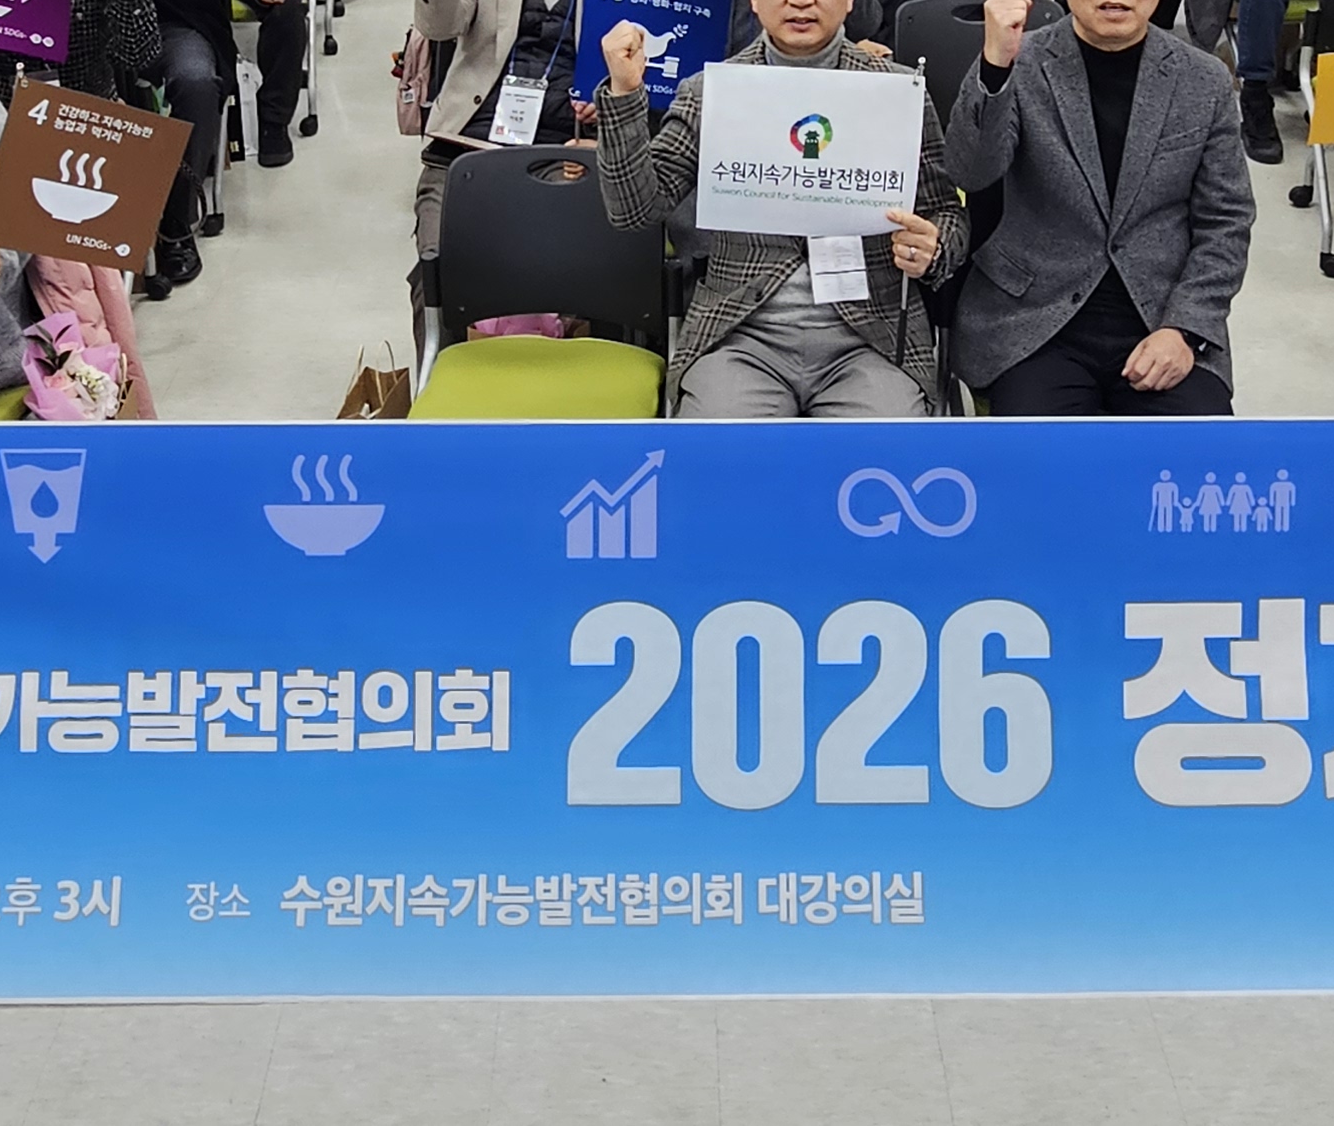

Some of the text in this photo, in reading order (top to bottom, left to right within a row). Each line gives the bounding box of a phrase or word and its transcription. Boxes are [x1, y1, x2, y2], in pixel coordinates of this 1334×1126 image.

[28, 99, 50, 125] 4
[58, 103, 154, 139] 건강하고 지속가능한
[54, 118, 123, 144] 농업과 먹거리
[711, 160, 906, 193] 수원지속가능발전협의회
[711, 185, 904, 209] Suwon Council for Sustainable Development
[66, 234, 82, 245] UN
[566, 599, 1053, 811] 2026
[53, 875, 122, 927] 3시
[186, 881, 251, 921] 장소
[280, 872, 743, 927] 수원지속가능발전협의회
[757, 872, 925, 926] 대강의실
